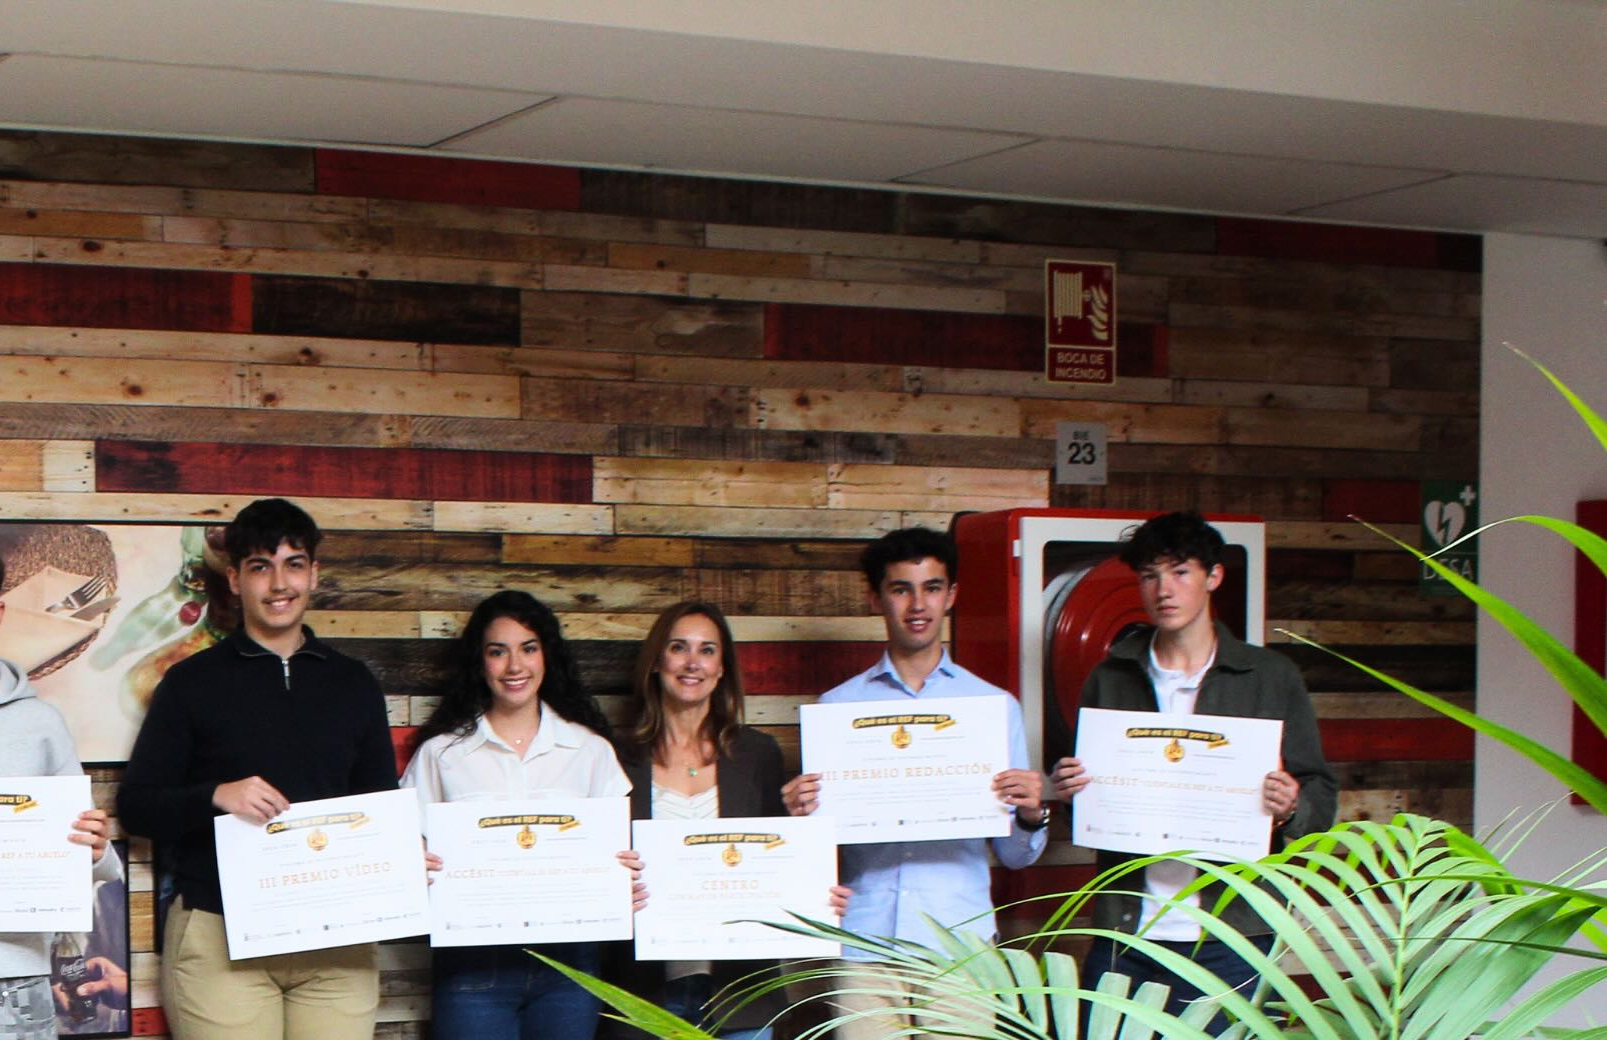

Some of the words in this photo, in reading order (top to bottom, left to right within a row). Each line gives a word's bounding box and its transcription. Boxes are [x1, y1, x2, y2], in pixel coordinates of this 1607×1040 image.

[1057, 352, 1088, 365] BOCA
[1090, 353, 1105, 366] DE
[1055, 367, 1107, 380] INCENDIO
[1068, 442, 1096, 465] 23
[842, 767, 899, 781] PREMIO
[905, 763, 992, 779] REDACCIÓN
[258, 876, 277, 889] III
[281, 867, 339, 887] PREMIO
[345, 861, 392, 878] VÍDEO
[701, 879, 759, 891] CENTRO
